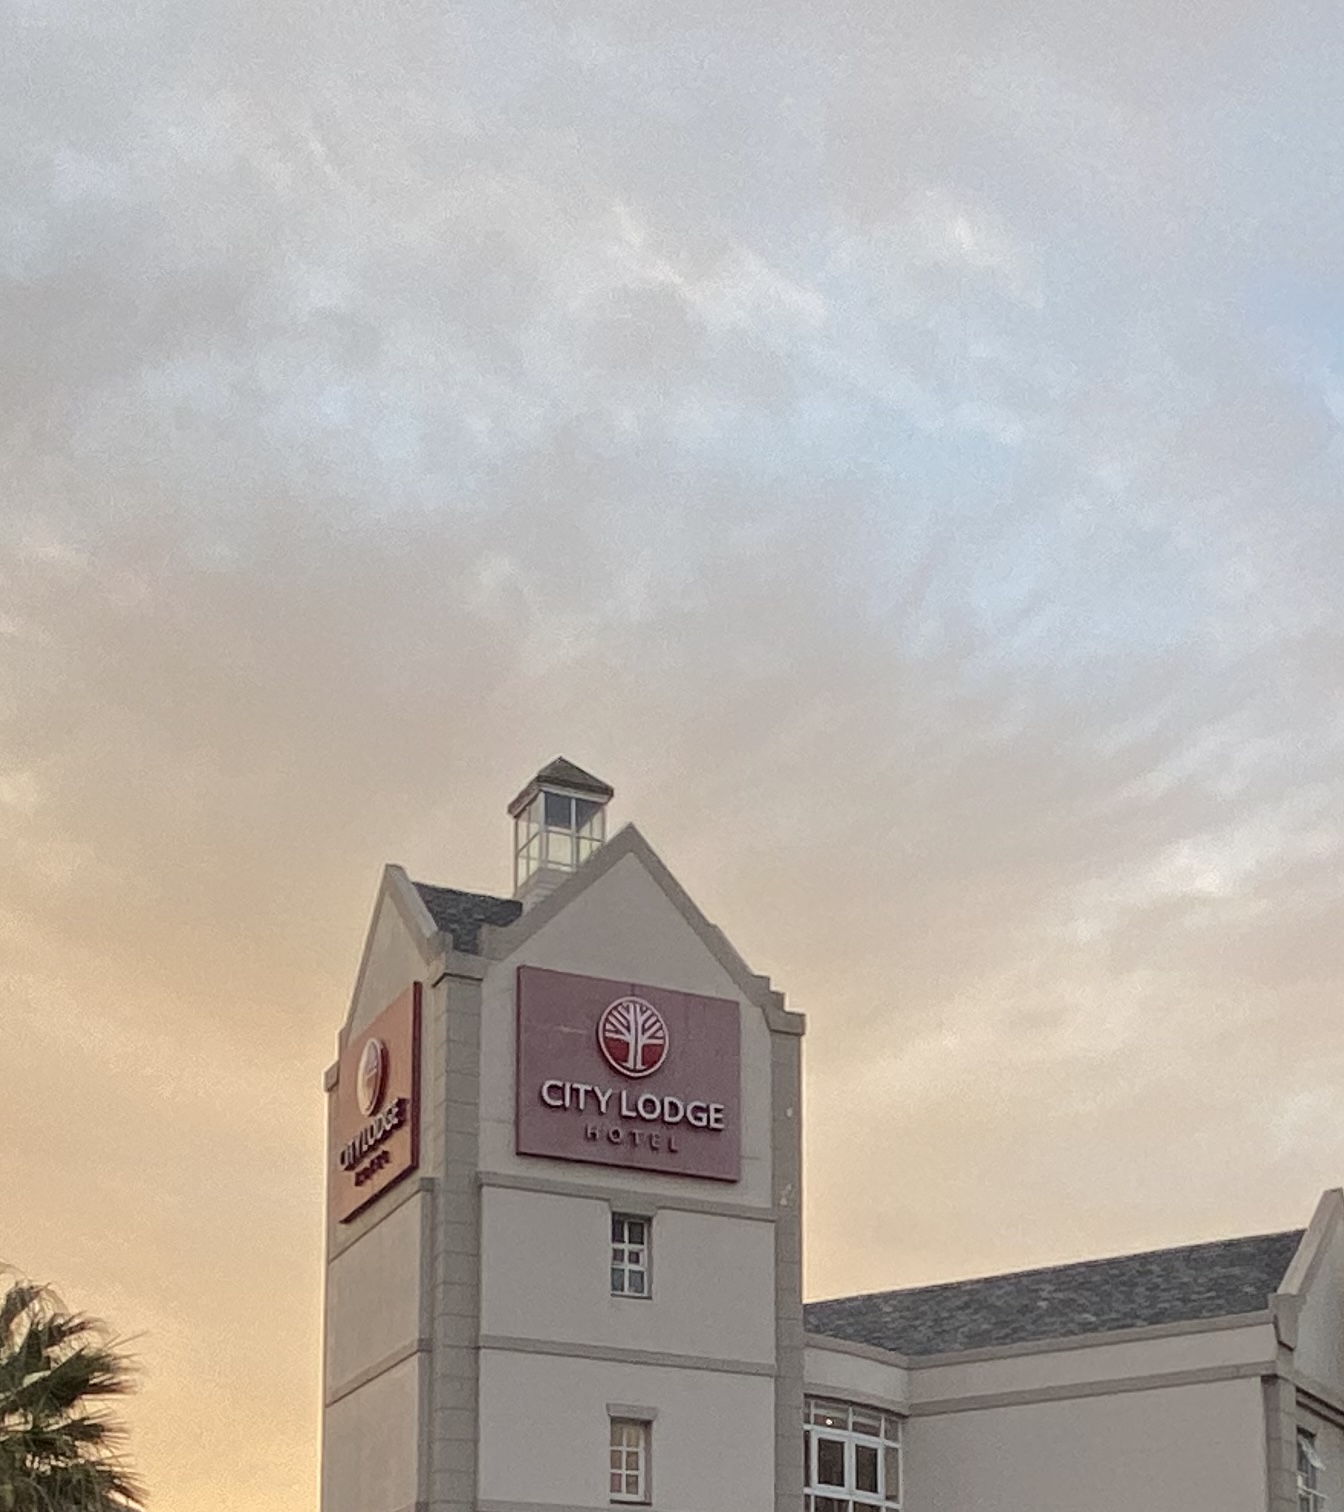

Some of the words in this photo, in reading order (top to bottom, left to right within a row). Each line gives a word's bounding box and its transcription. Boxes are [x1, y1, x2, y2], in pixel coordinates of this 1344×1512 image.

[541, 1079, 613, 1114] CITY
[620, 1090, 726, 1130] LODGE
[585, 1124, 679, 1153] HOTEL
